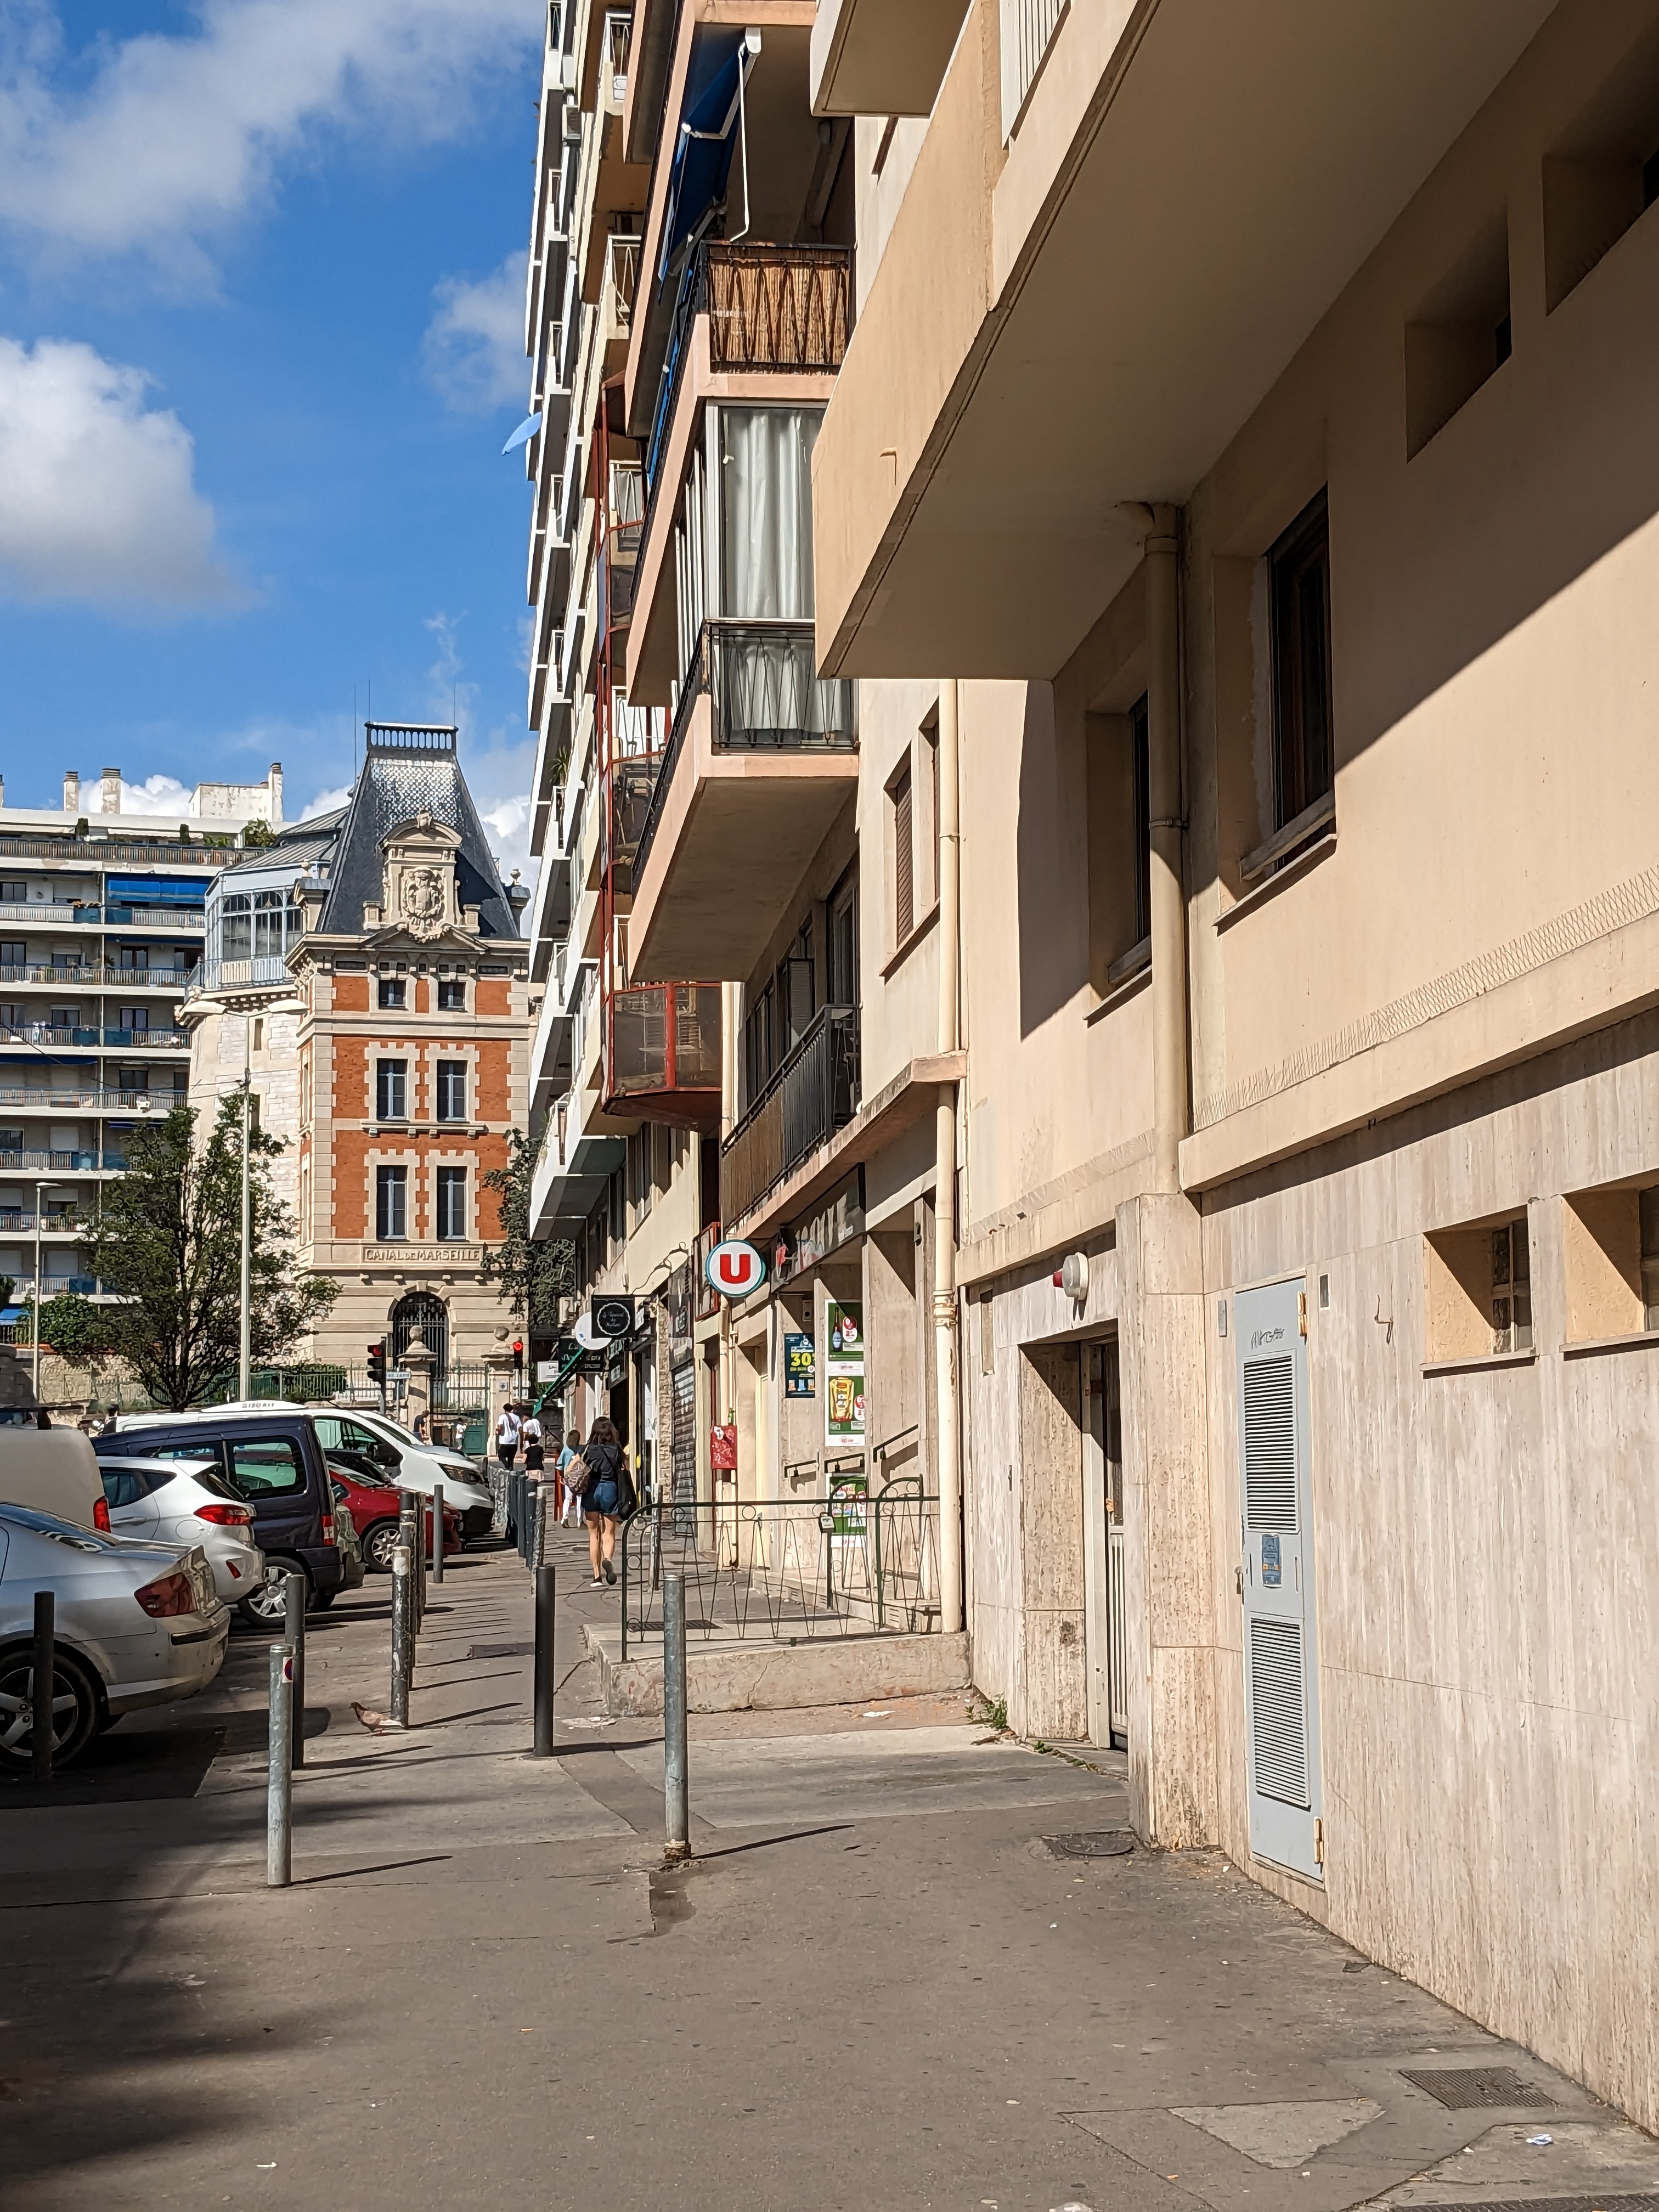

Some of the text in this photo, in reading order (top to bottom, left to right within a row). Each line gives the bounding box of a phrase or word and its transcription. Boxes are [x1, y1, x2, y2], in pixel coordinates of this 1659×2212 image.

[366, 1249, 403, 1260] CANAL
[417, 1250, 479, 1261] MARSEILLE
[720, 1254, 751, 1284] U
